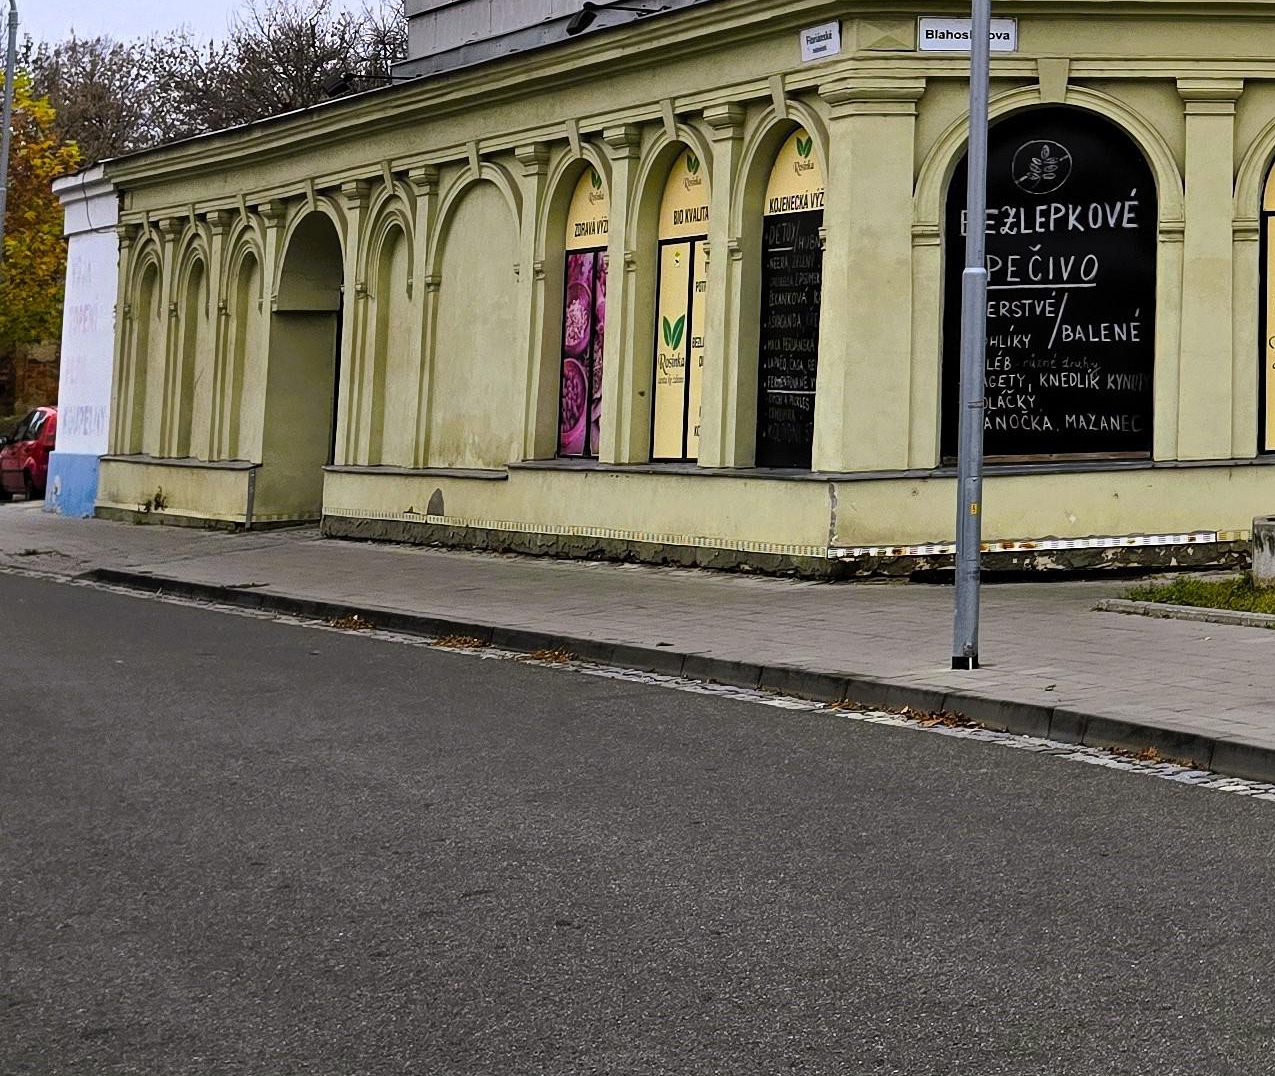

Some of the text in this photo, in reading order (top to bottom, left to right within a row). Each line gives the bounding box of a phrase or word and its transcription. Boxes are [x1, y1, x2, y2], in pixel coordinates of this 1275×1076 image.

[925, 29, 1010, 40] Blahoslova
[769, 188, 825, 214] KOJENECKÁ VÝŽ
[673, 205, 709, 226] BIO KVALITA
[574, 217, 596, 238] ZDRAVÁ
[986, 244, 1099, 282] PEČIVO
[986, 290, 1141, 342] ERSTVÉ BALENÉ
[987, 324, 1031, 349] HLÍKY
[986, 350, 1012, 371] LÉB
[1039, 368, 1100, 390] KNEDLÍK
